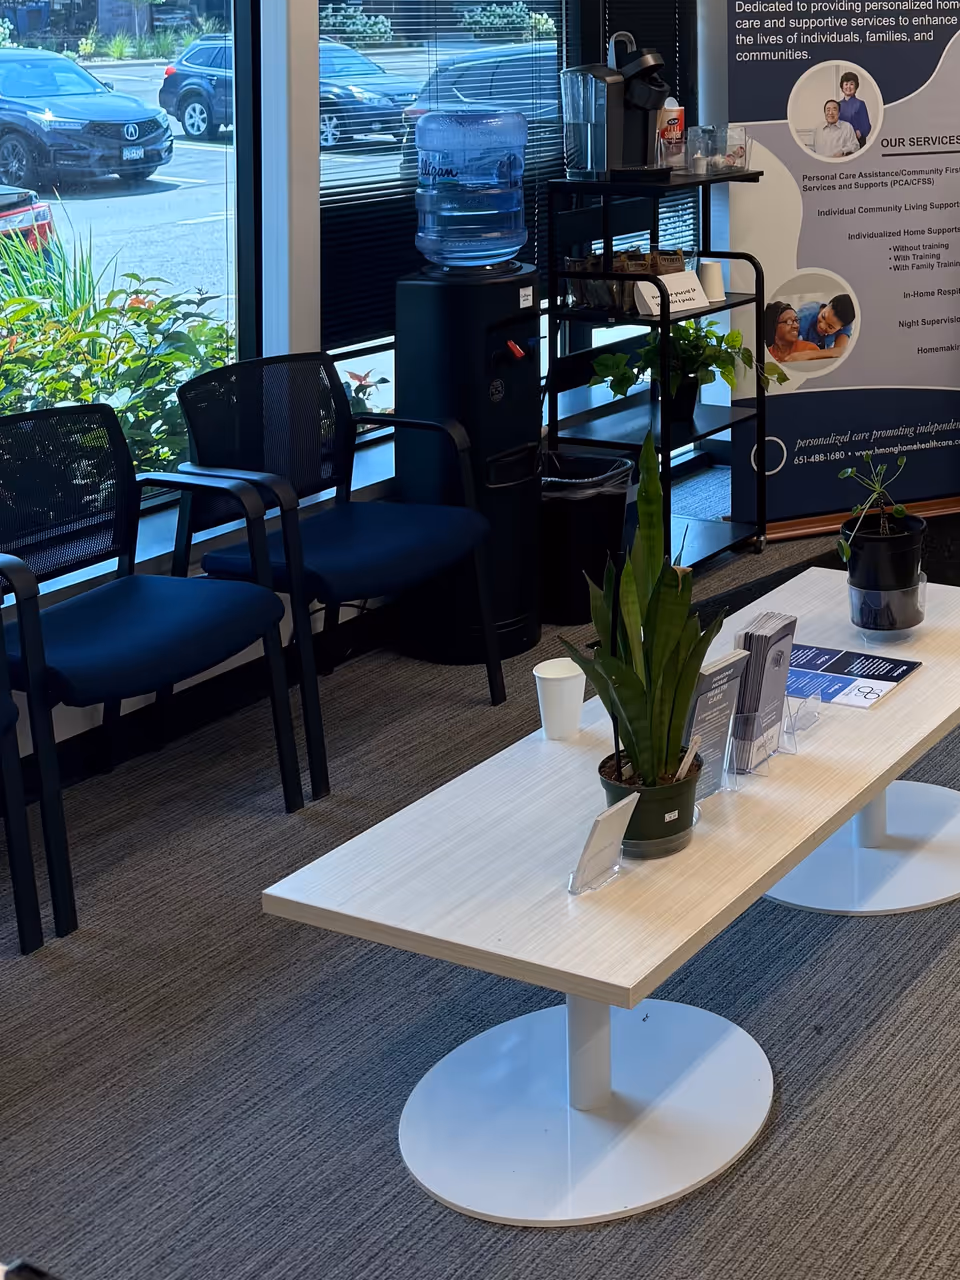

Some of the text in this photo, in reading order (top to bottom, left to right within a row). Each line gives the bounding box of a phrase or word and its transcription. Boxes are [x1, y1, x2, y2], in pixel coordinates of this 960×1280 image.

[736, 1, 793, 12] Dedicated
[797, 1, 807, 11] to
[811, 0, 861, 13] providing
[865, 0, 933, 12] personalized
[736, 15, 957, 29] care and supportive services to enhance
[736, 30, 933, 44] the lives of individuals, families, and
[736, 49, 811, 60] communities.
[881, 138, 905, 148] OUR
[803, 173, 837, 182] Personal
[839, 171, 856, 180] Care
[858, 167, 943, 179] Assistance/Community
[803, 178, 935, 192] Services and Supports (PCA/CFSS)
[818, 207, 856, 216] Individual
[858, 204, 902, 214] Community
[905, 203, 927, 212] Living
[849, 230, 901, 240] Individualized
[903, 228, 925, 236] Home
[893, 242, 949, 252] Without training
[912, 252, 941, 261] Training
[912, 263, 934, 271] Family
[904, 289, 935, 299] In-Home
[899, 320, 919, 329] Night
[795, 431, 851, 451] personalized
[871, 425, 914, 442] promoting
[794, 451, 845, 464] 651-488-1680
